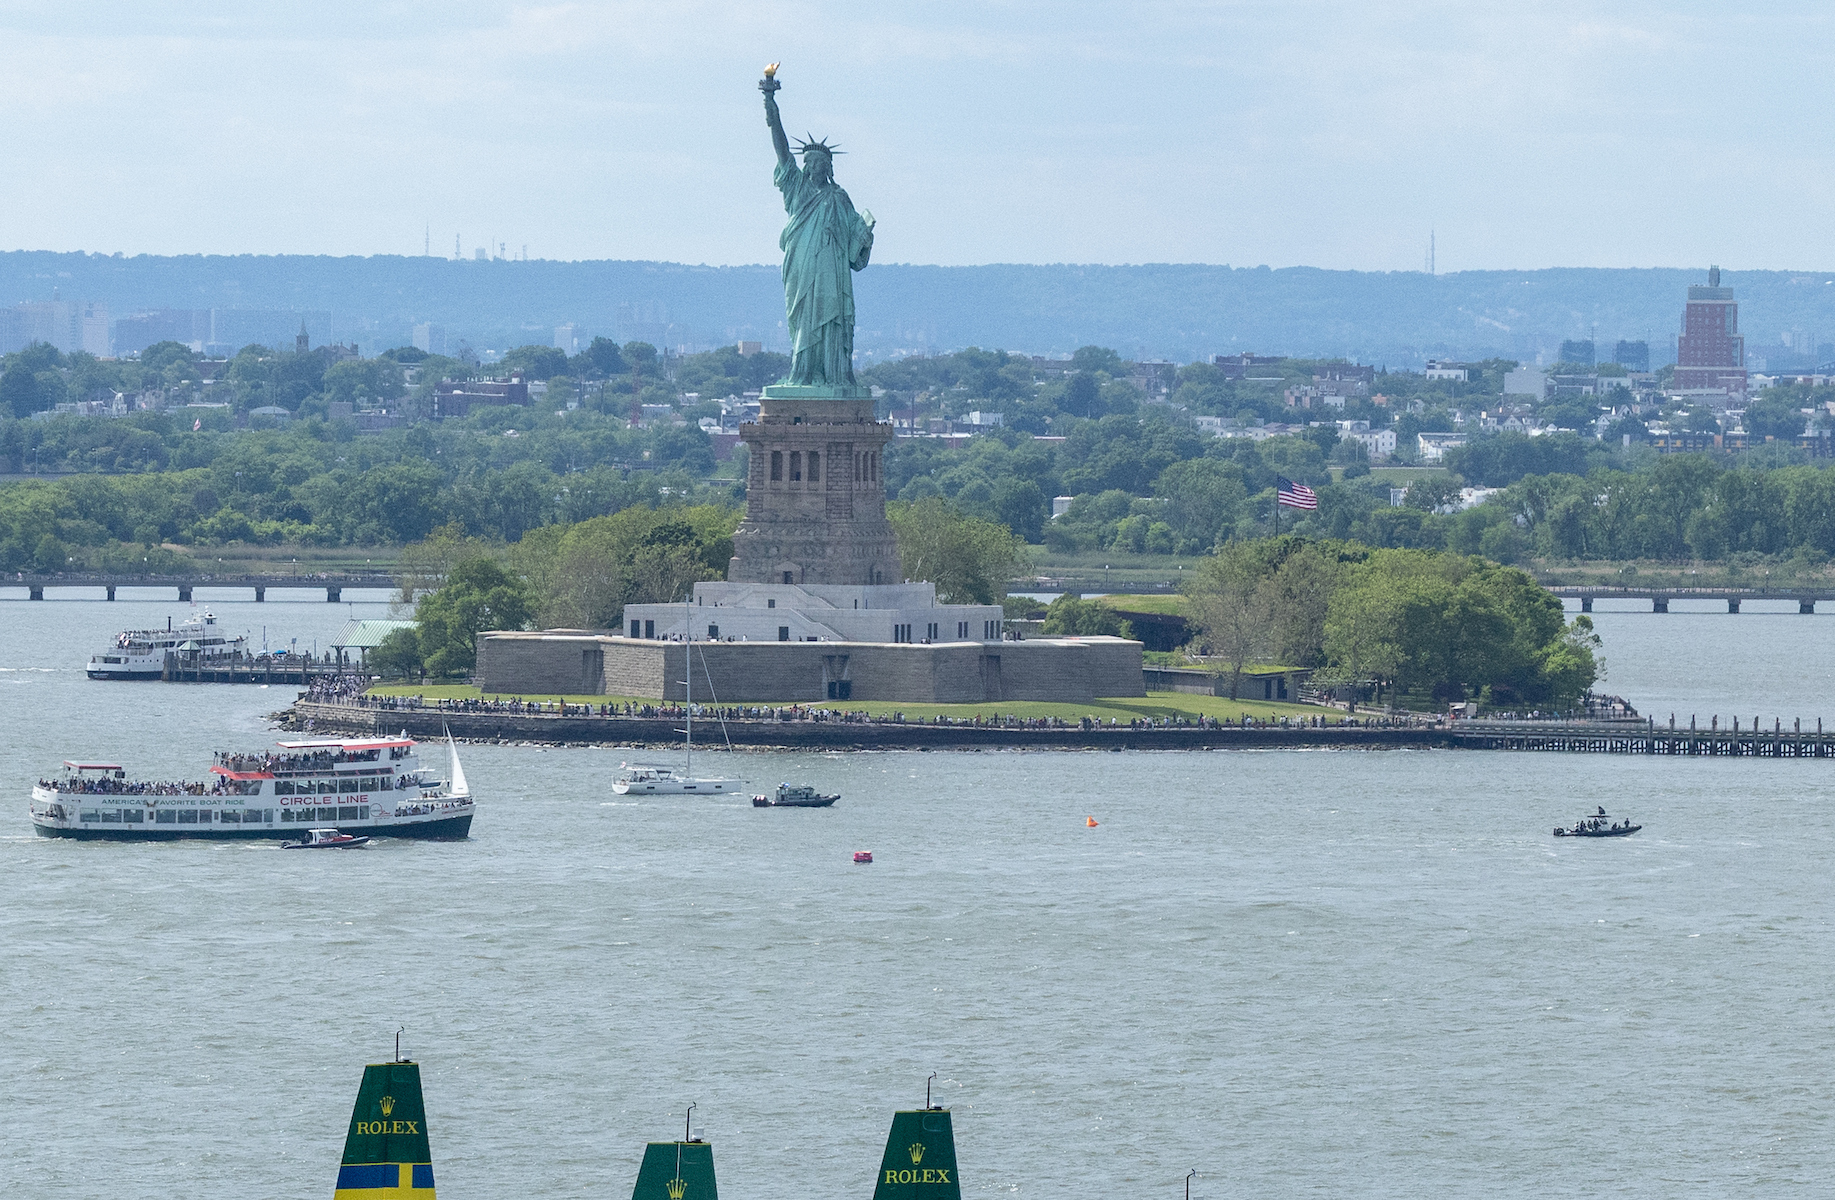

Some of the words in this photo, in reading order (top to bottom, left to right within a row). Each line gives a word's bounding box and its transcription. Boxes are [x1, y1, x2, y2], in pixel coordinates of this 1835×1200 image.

[280, 796, 332, 806] CIRCLE
[337, 794, 368, 804] LINE
[356, 1121, 419, 1135] ROLEX
[885, 1169, 951, 1184] ROLEX
